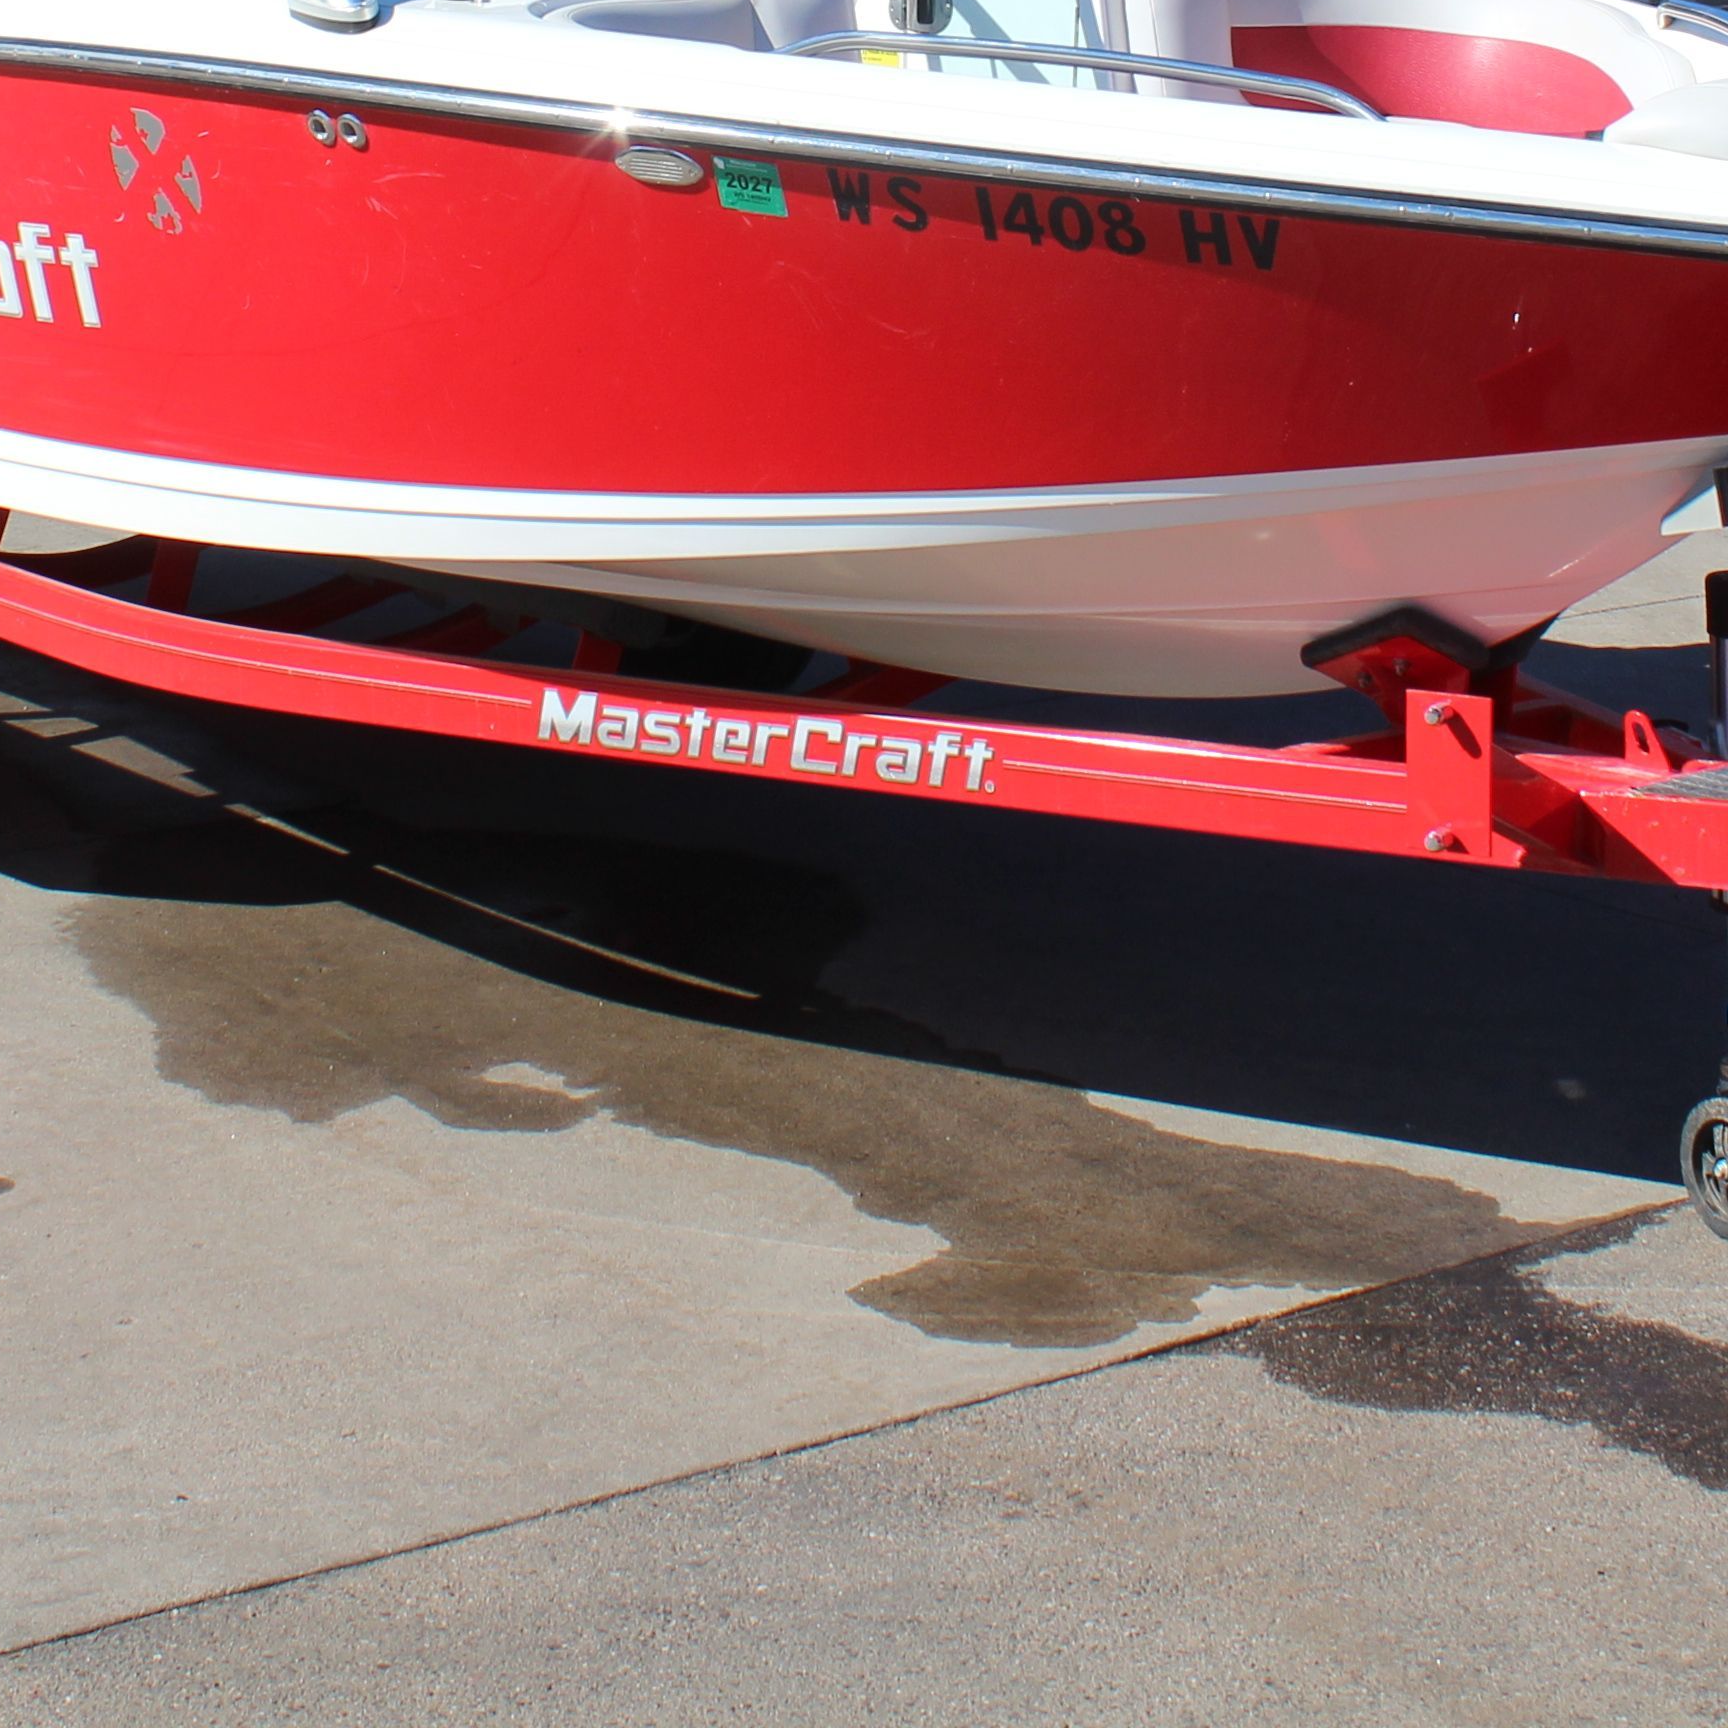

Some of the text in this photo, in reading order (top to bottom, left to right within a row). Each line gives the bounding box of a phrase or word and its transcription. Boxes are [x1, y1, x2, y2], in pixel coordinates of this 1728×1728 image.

[725, 172, 773, 194] 2027
[826, 168, 1281, 271] WS 1408 HV
[537, 687, 994, 793] MasterCraft
